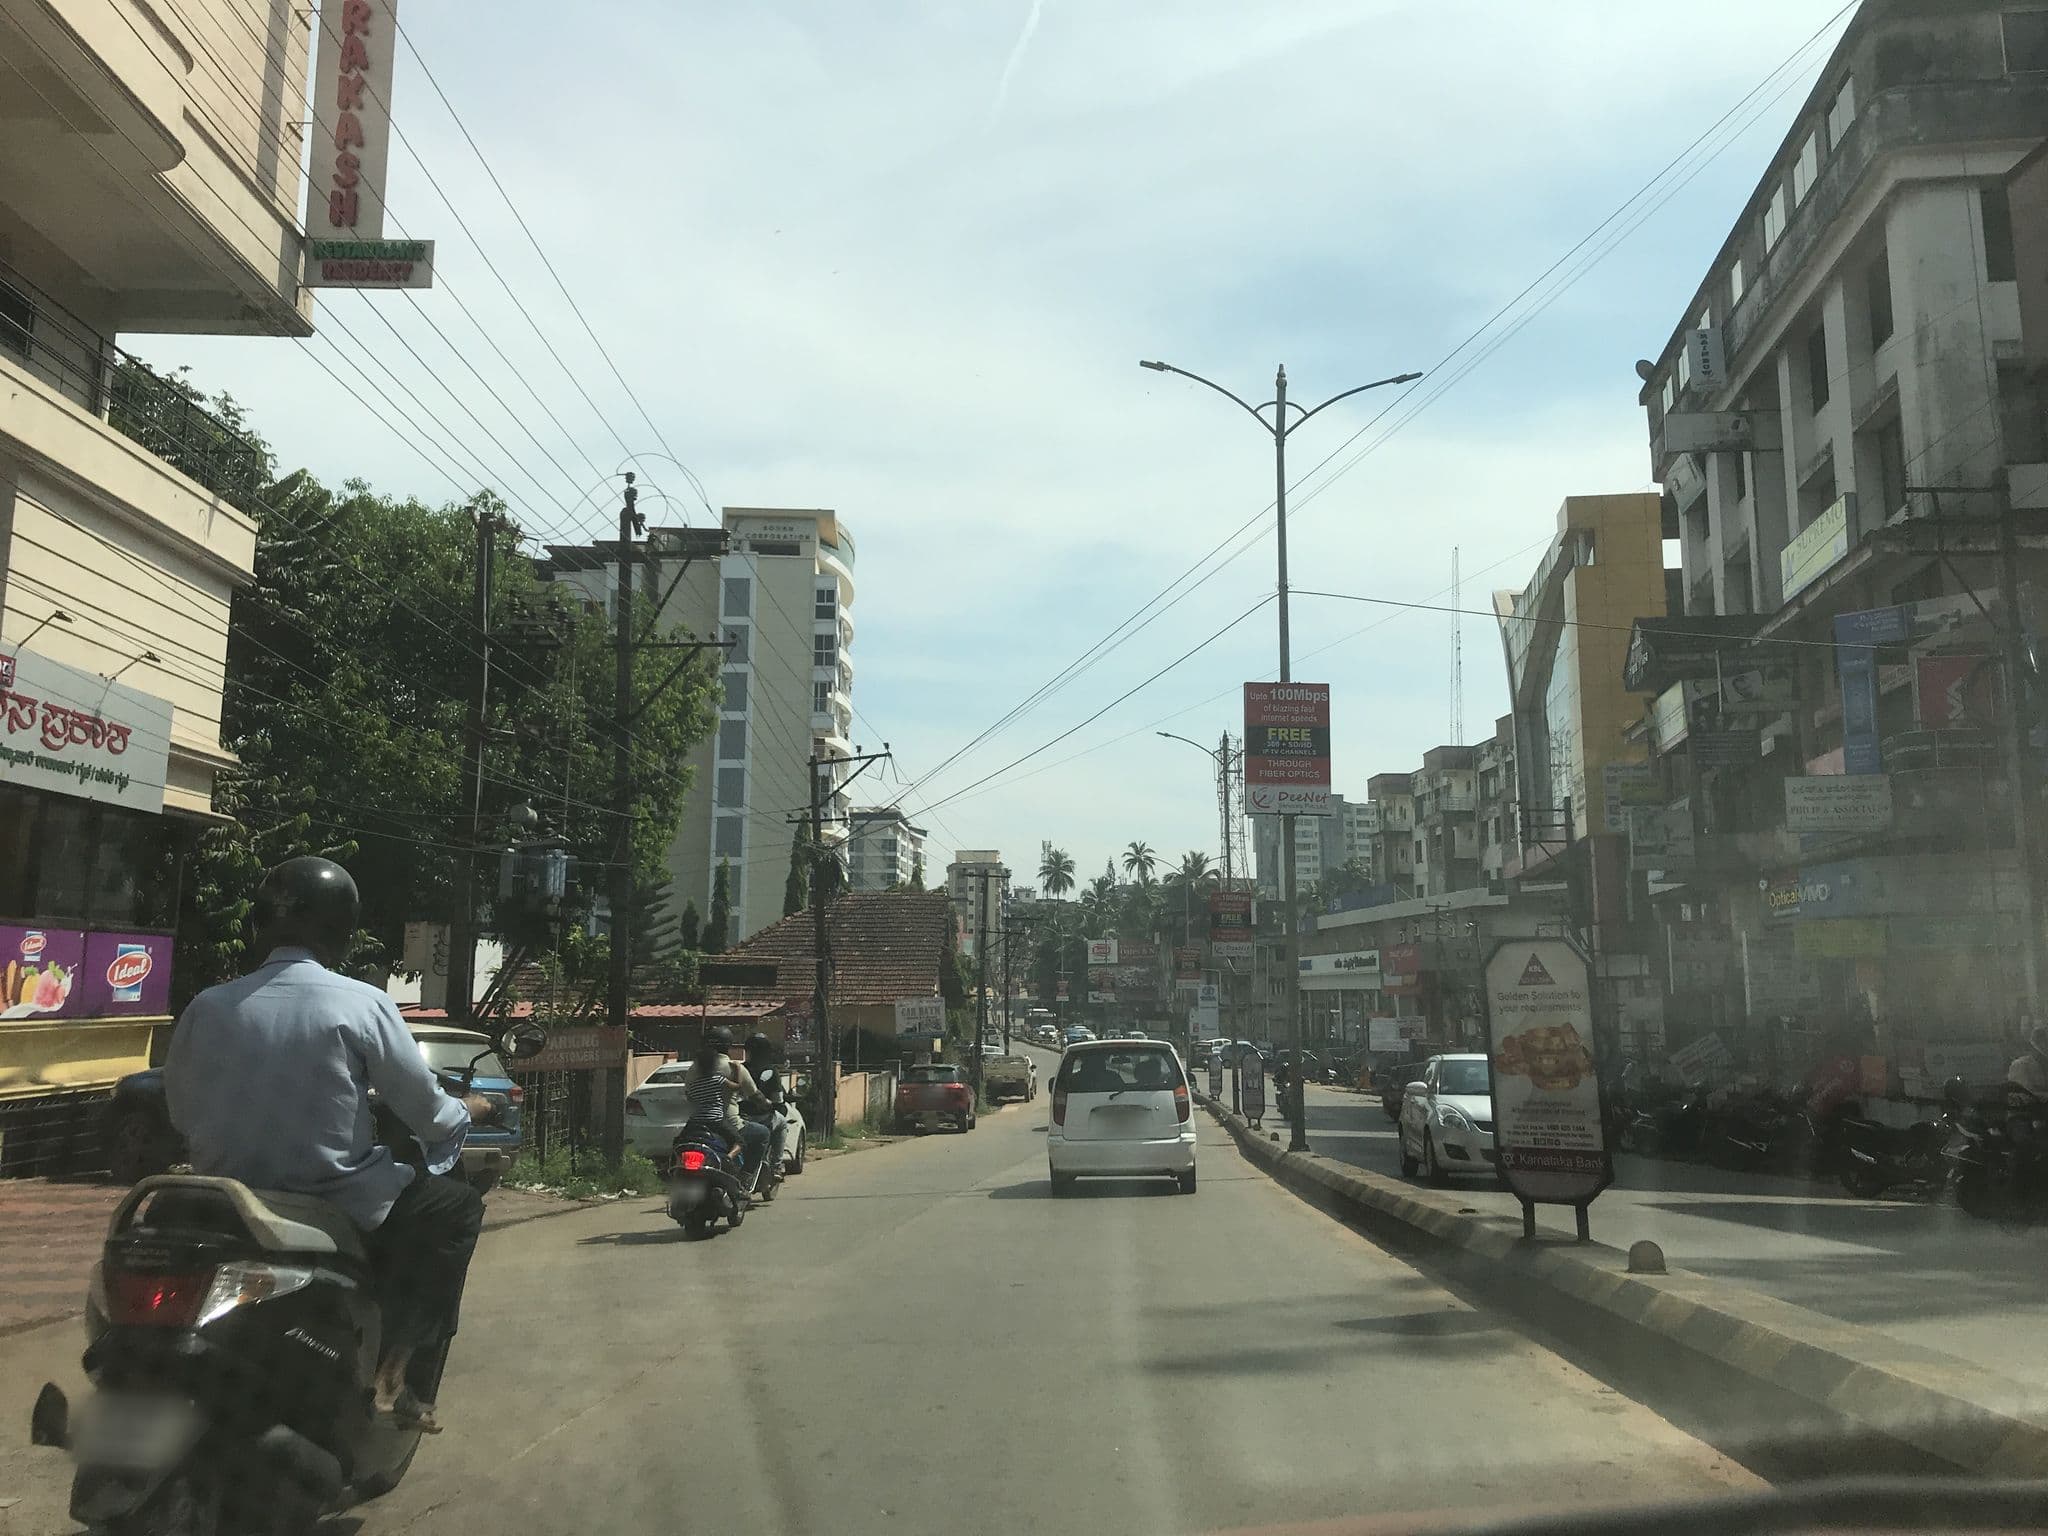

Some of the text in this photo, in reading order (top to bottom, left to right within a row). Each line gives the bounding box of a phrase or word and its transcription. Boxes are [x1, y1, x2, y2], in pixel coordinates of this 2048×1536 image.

[1270, 688, 1328, 704] 100Mbps
[1267, 727, 1311, 741] FREE
[1268, 760, 1312, 768] THROUGH
[1260, 769, 1284, 778] FIBER
[113, 957, 148, 981] Ideal
[1497, 991, 1529, 1001] Golden
[1519, 1153, 1604, 1169] Karnataka Bank
